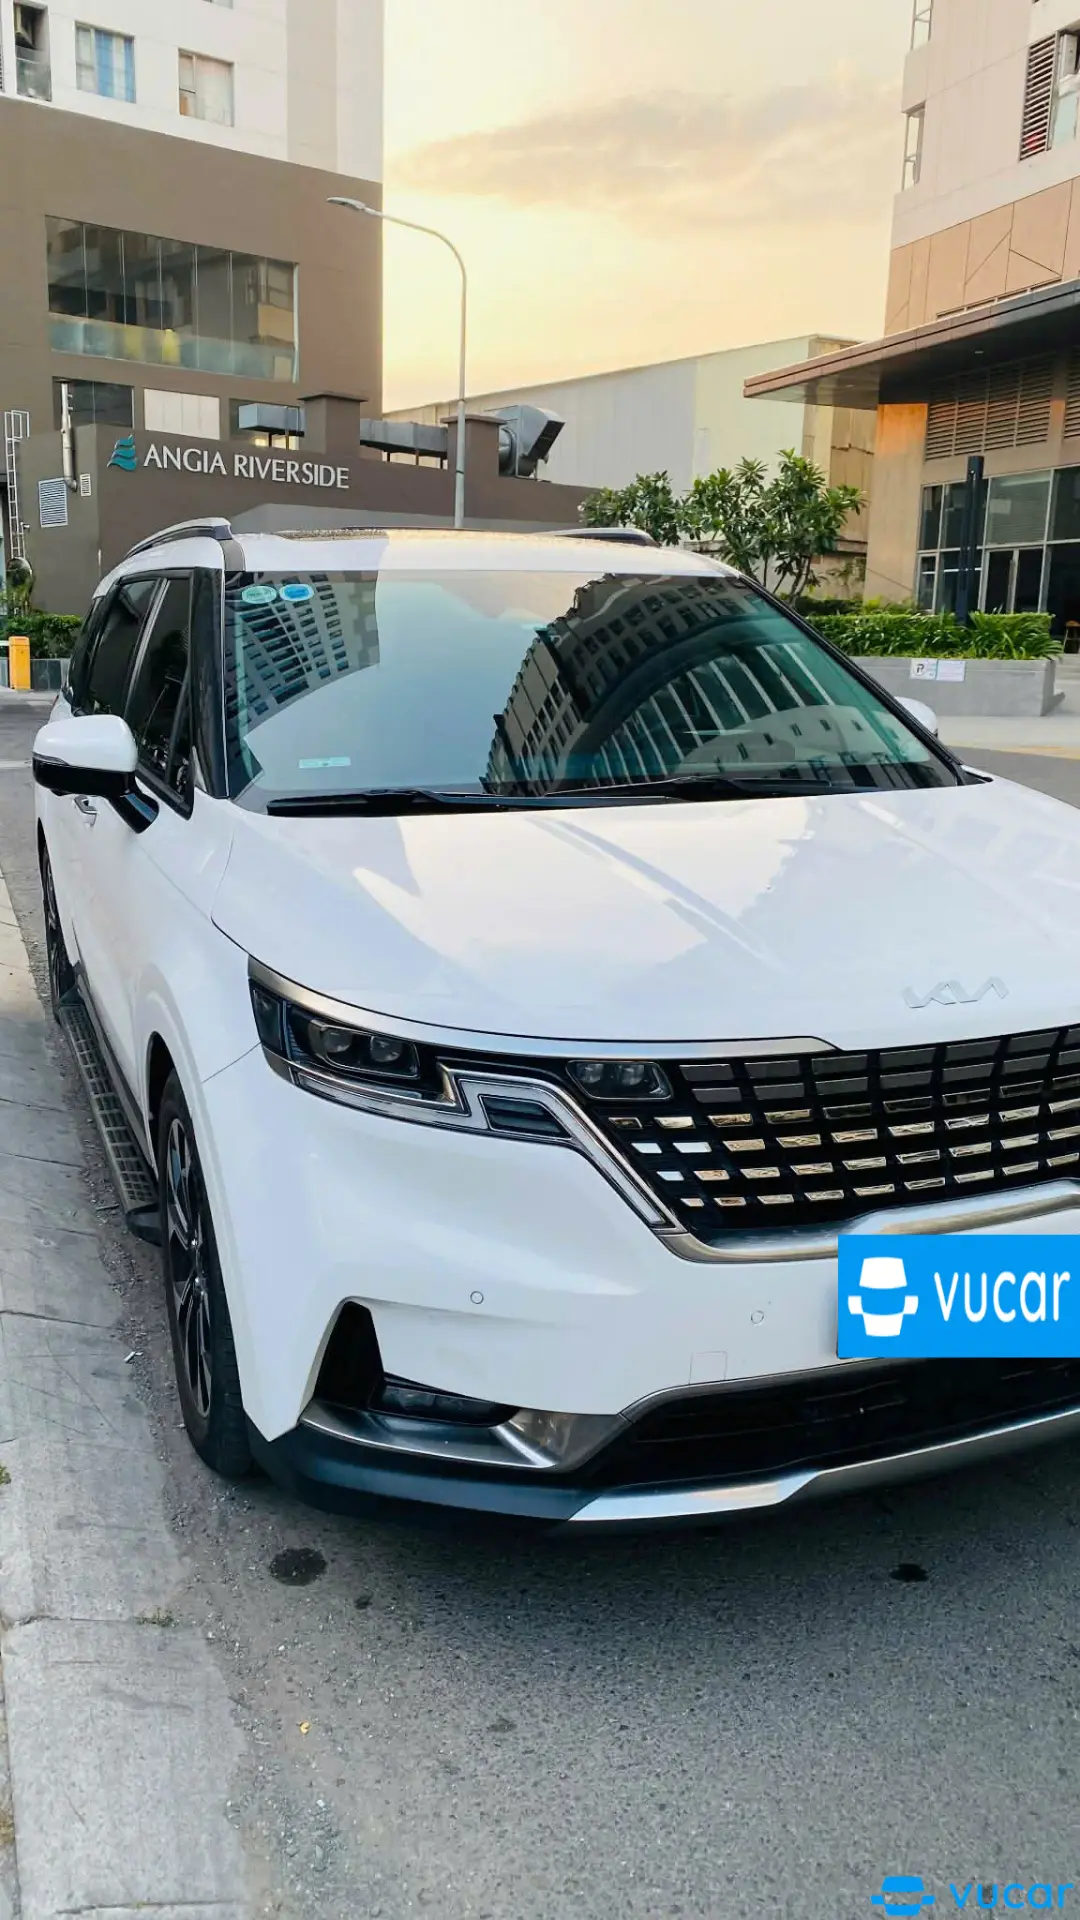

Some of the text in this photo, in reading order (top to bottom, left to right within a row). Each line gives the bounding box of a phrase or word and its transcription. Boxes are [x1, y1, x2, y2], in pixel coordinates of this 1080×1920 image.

[144, 443, 349, 488] ANGIA RIVERSIDE
[901, 977, 1009, 1009] KIA
